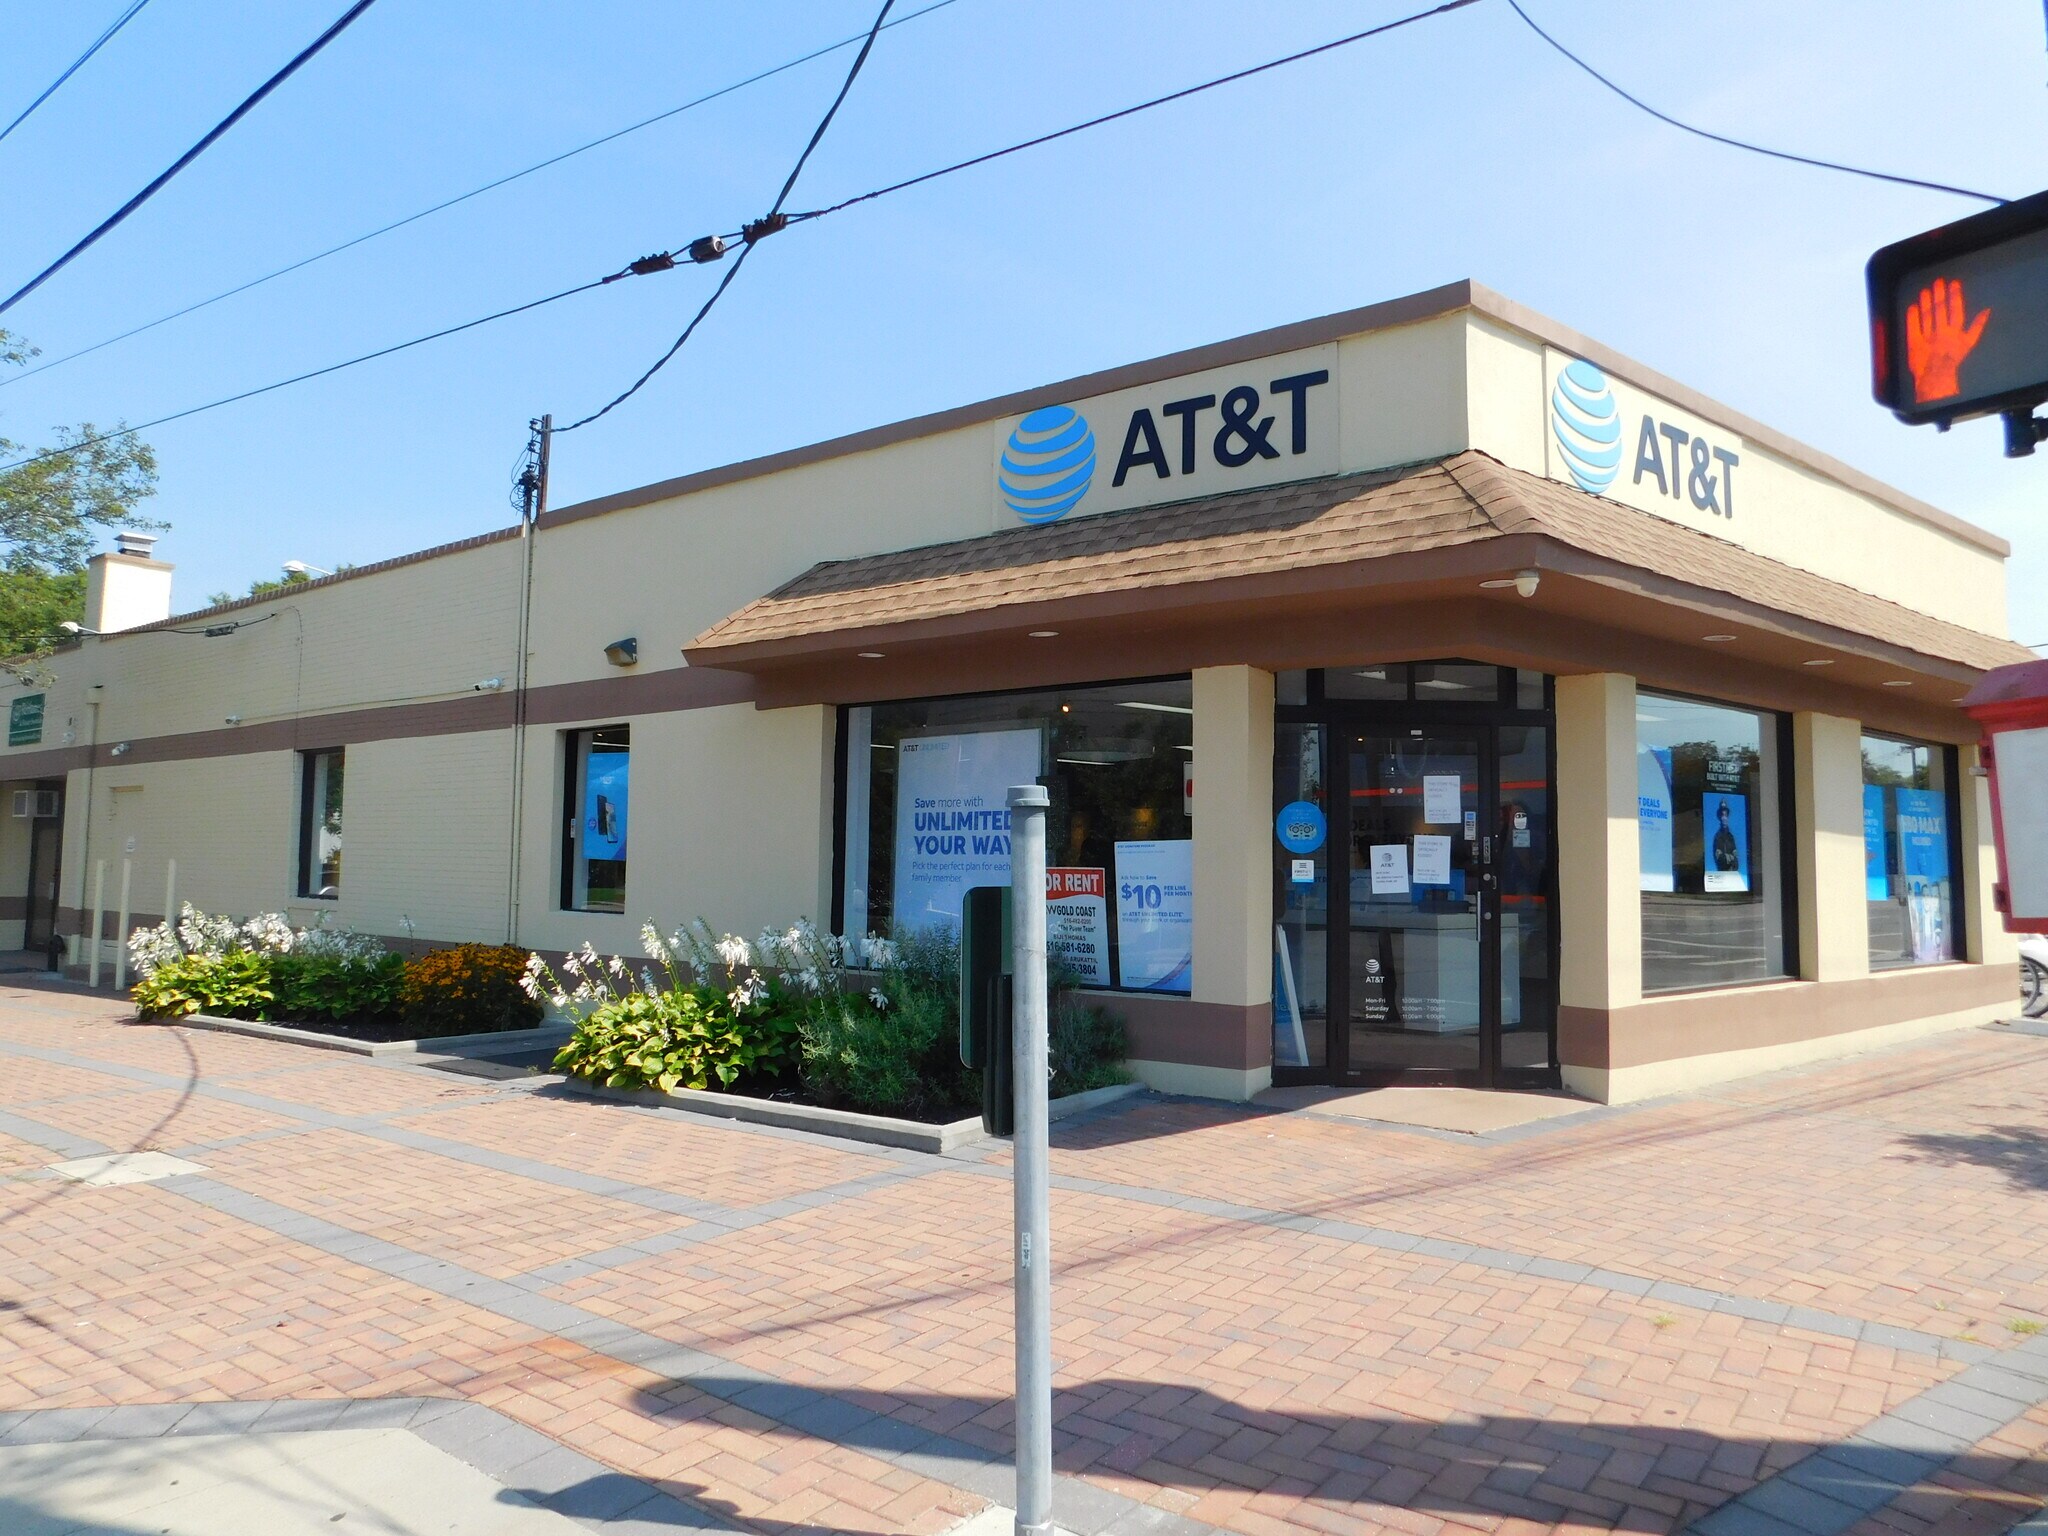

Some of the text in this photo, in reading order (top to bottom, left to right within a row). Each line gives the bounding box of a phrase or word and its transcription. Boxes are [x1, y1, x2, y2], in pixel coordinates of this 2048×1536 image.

[1112, 369, 1329, 488] AT&T
[1632, 414, 1740, 520] AT&T
[903, 744, 919, 752] AT&T
[915, 796, 984, 809] Save more with
[1642, 799, 1660, 808] DEALS
[1640, 808, 1668, 819] EVERYONE
[914, 835, 1011, 855] YOUR WAY
[912, 861, 1011, 874] Pick the perfect plan for each
[912, 873, 932, 884] family
[1046, 873, 1100, 892] OR RENT
[1121, 882, 1161, 909] $10
[1057, 905, 1074, 916] GOLD
[1075, 906, 1096, 917] COAST
[1365, 976, 1385, 984] AT&T
